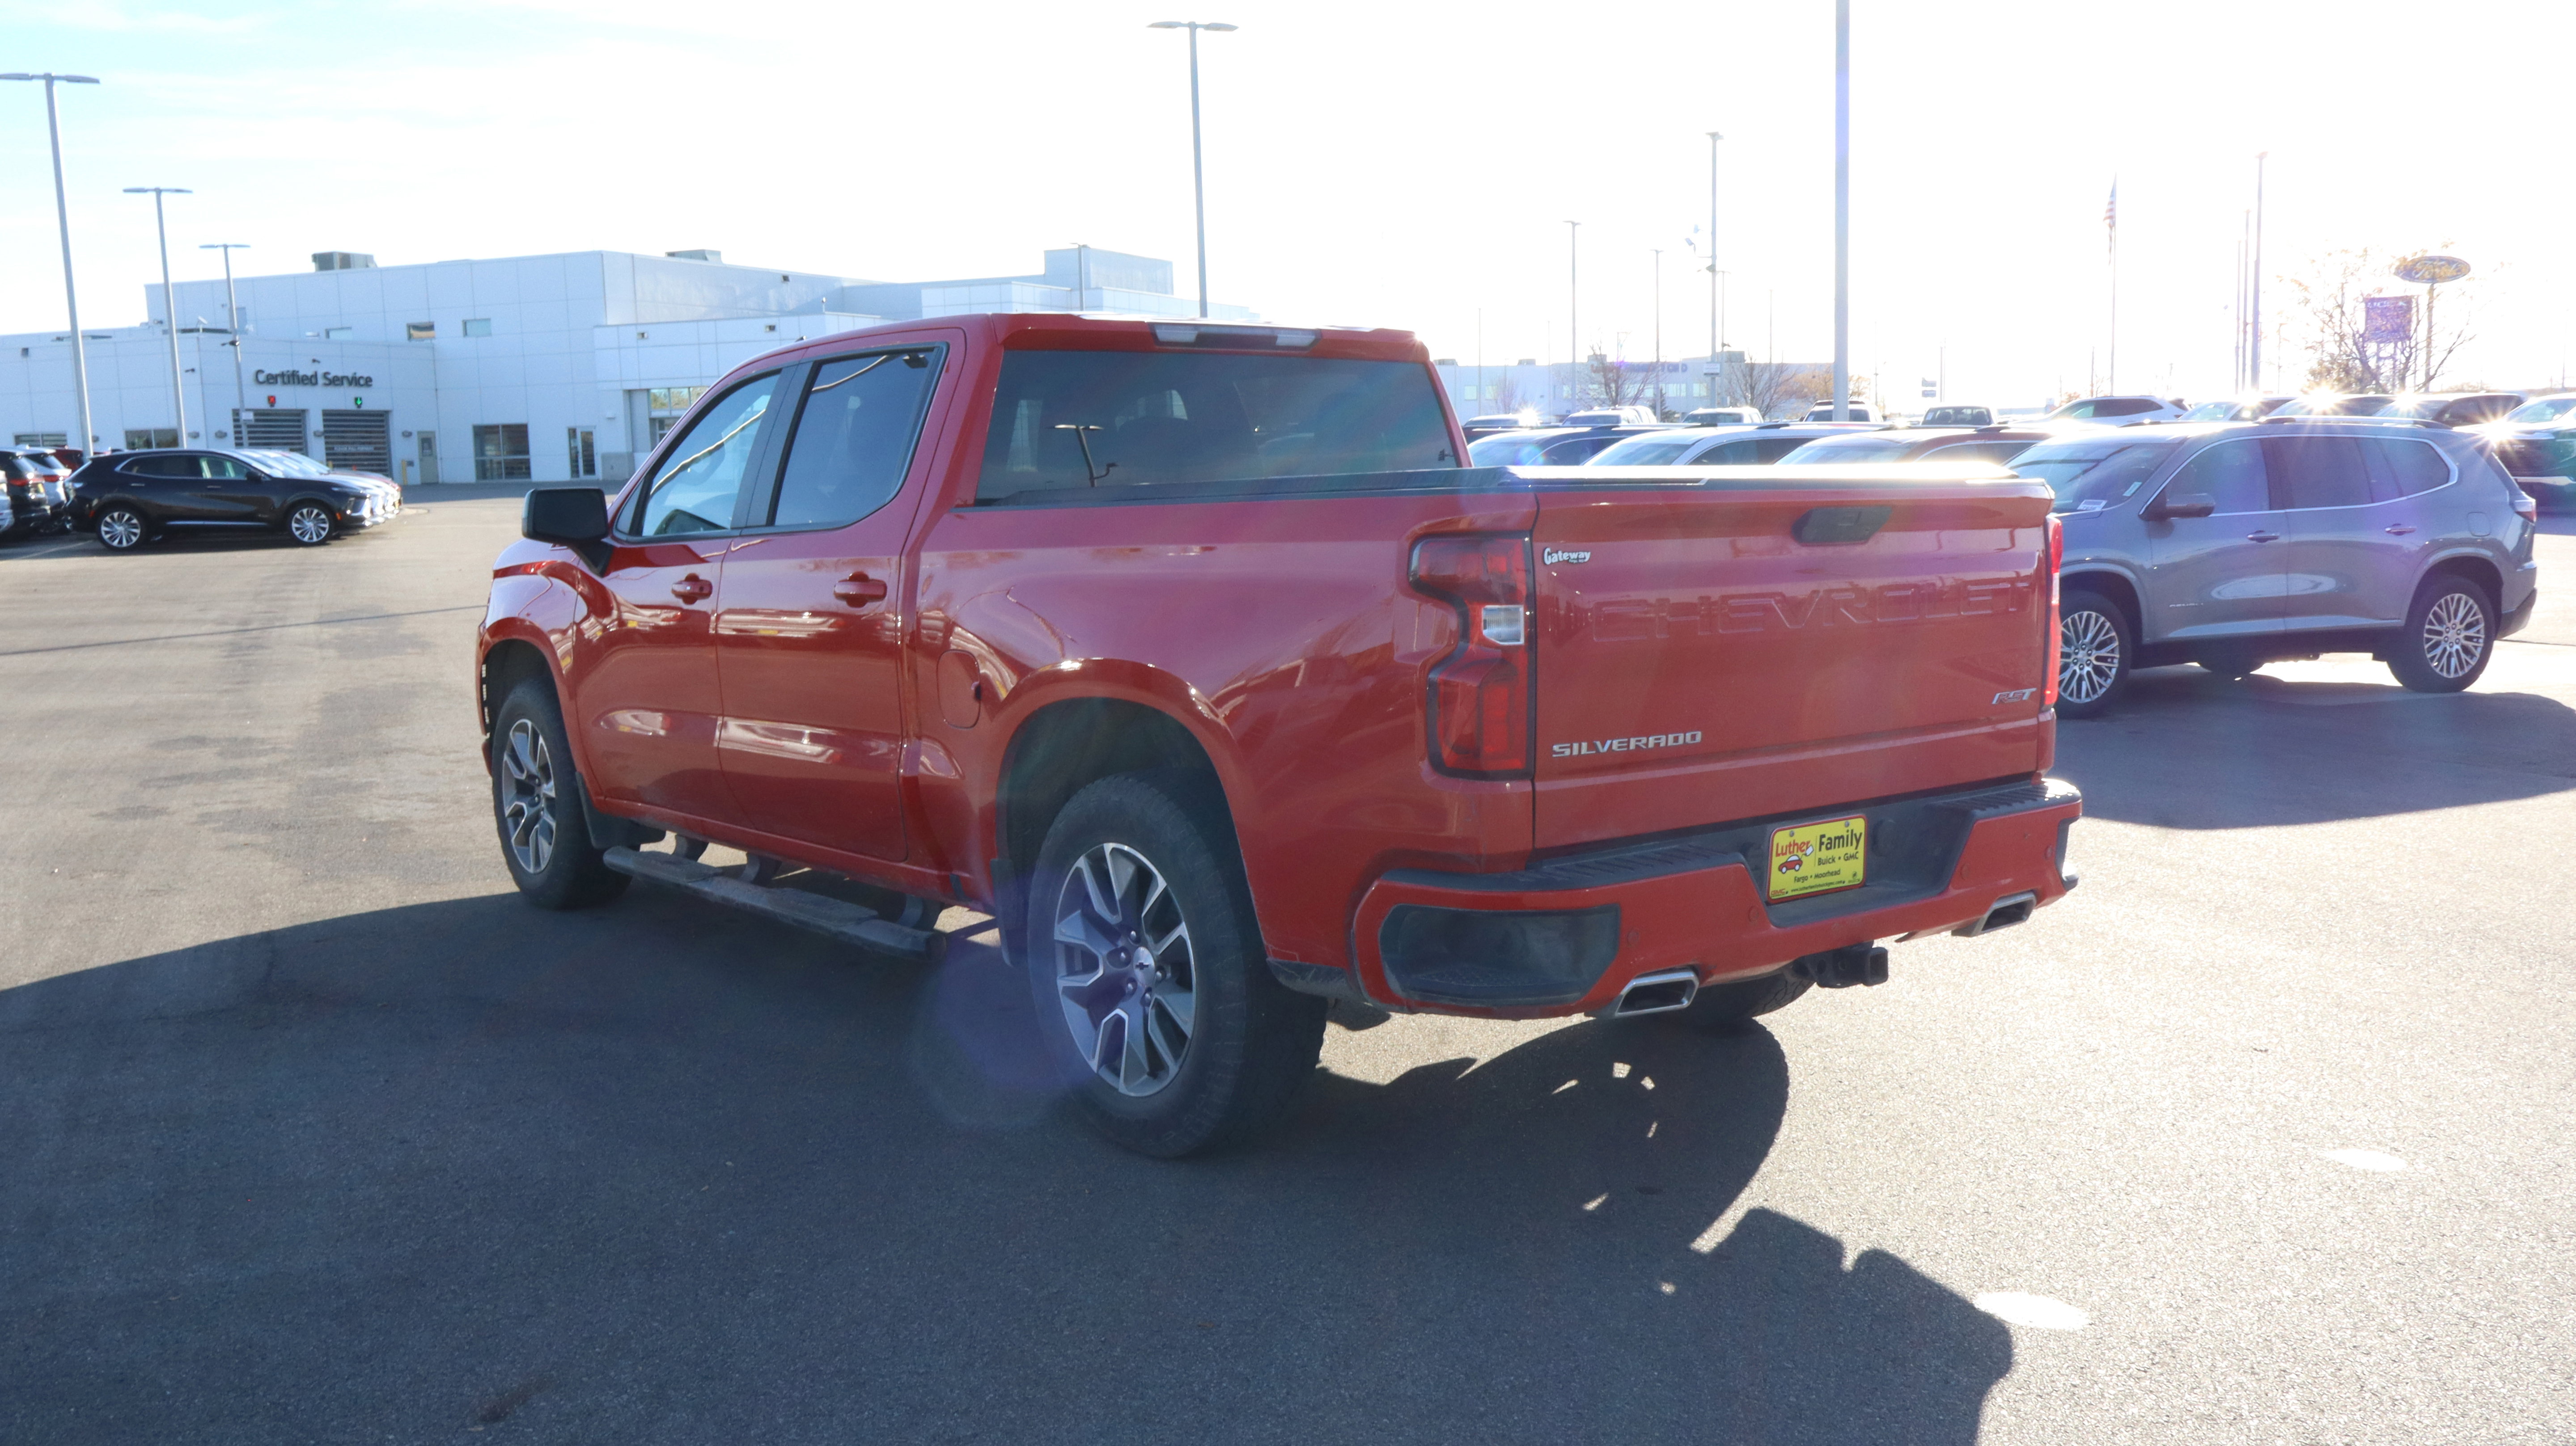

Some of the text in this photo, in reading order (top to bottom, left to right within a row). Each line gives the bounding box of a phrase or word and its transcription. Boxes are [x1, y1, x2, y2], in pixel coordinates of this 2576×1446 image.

[254, 369, 373, 386] Certified Service
[1543, 547, 1591, 565] Gateway
[1593, 578, 2031, 641] CHEVROLET
[1991, 687, 2037, 704] RST
[1552, 730, 1702, 757] SILVERADO
[1775, 829, 1863, 857] Luther Family
[1818, 852, 1859, 866] Buick GMC
[1794, 869, 1840, 883] Fargo Moorhead
